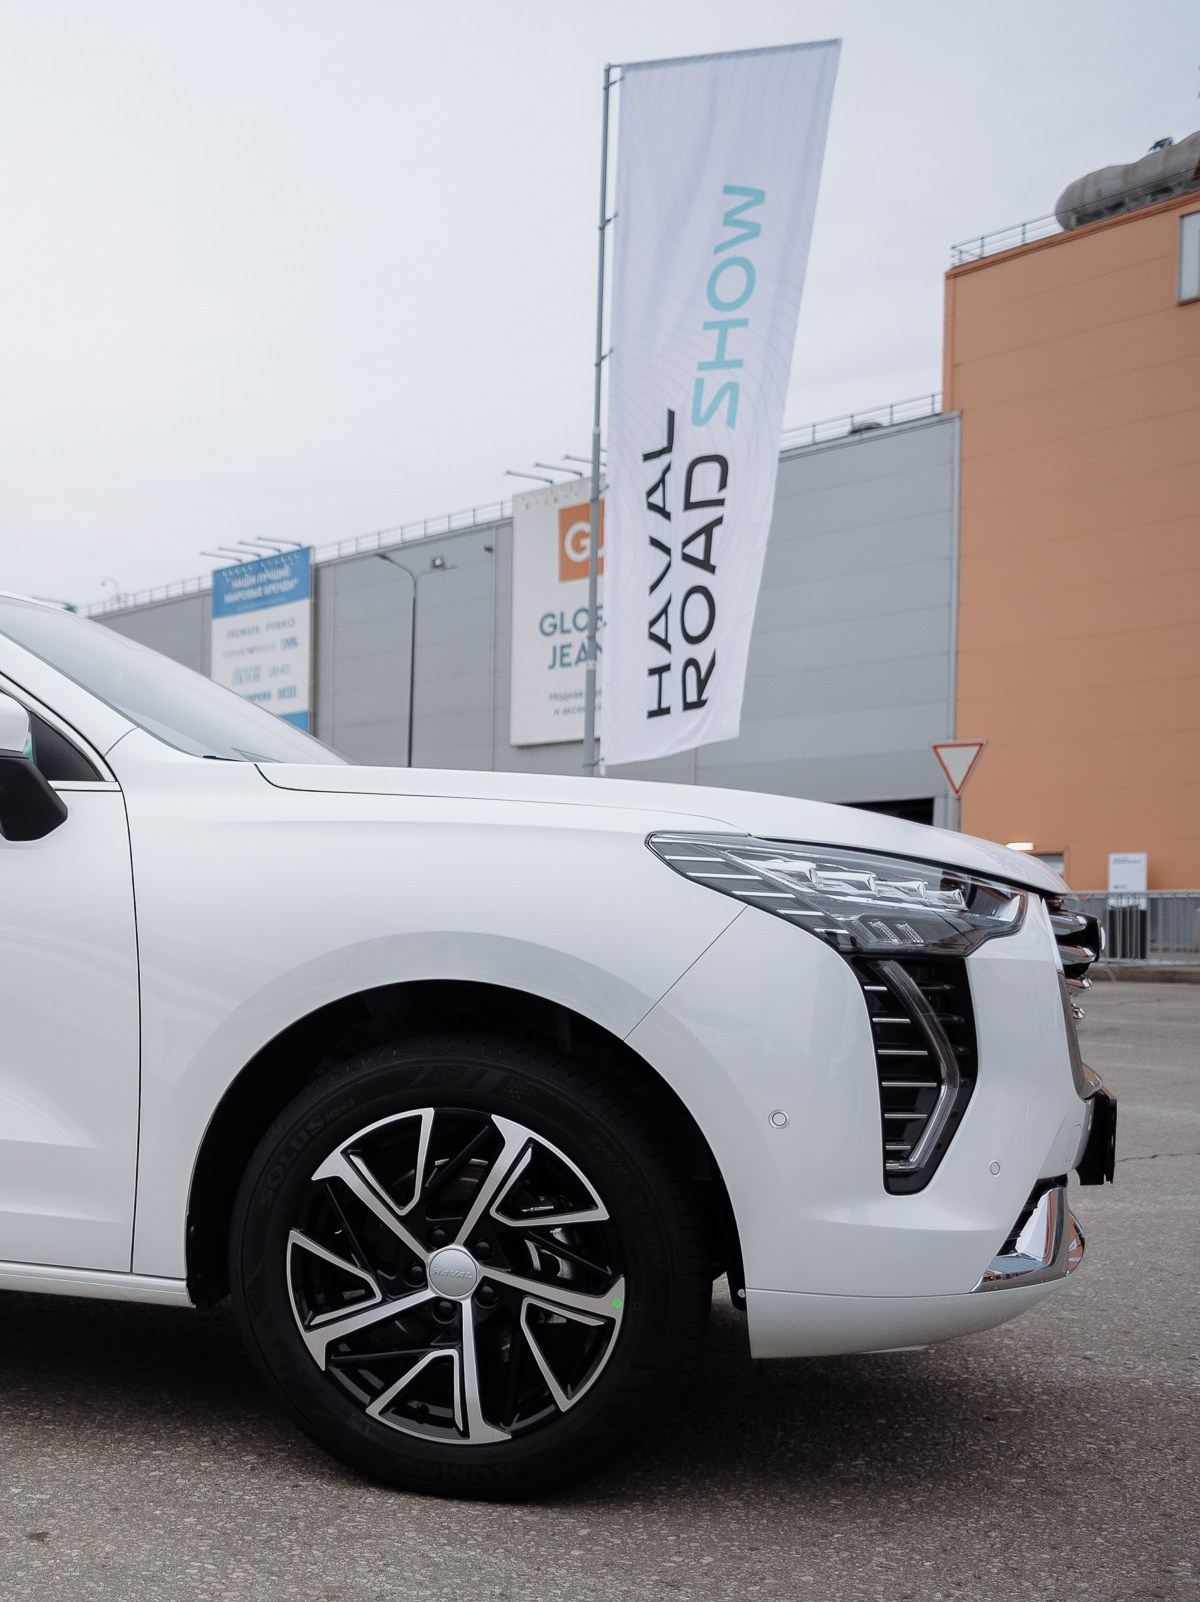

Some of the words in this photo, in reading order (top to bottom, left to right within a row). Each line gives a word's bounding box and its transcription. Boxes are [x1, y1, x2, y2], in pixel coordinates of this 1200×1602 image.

[691, 184, 766, 429] SHOW
[642, 408, 676, 719] HAVAL
[680, 454, 729, 711] ROAD
[433, 1268, 474, 1280] HAVAL
